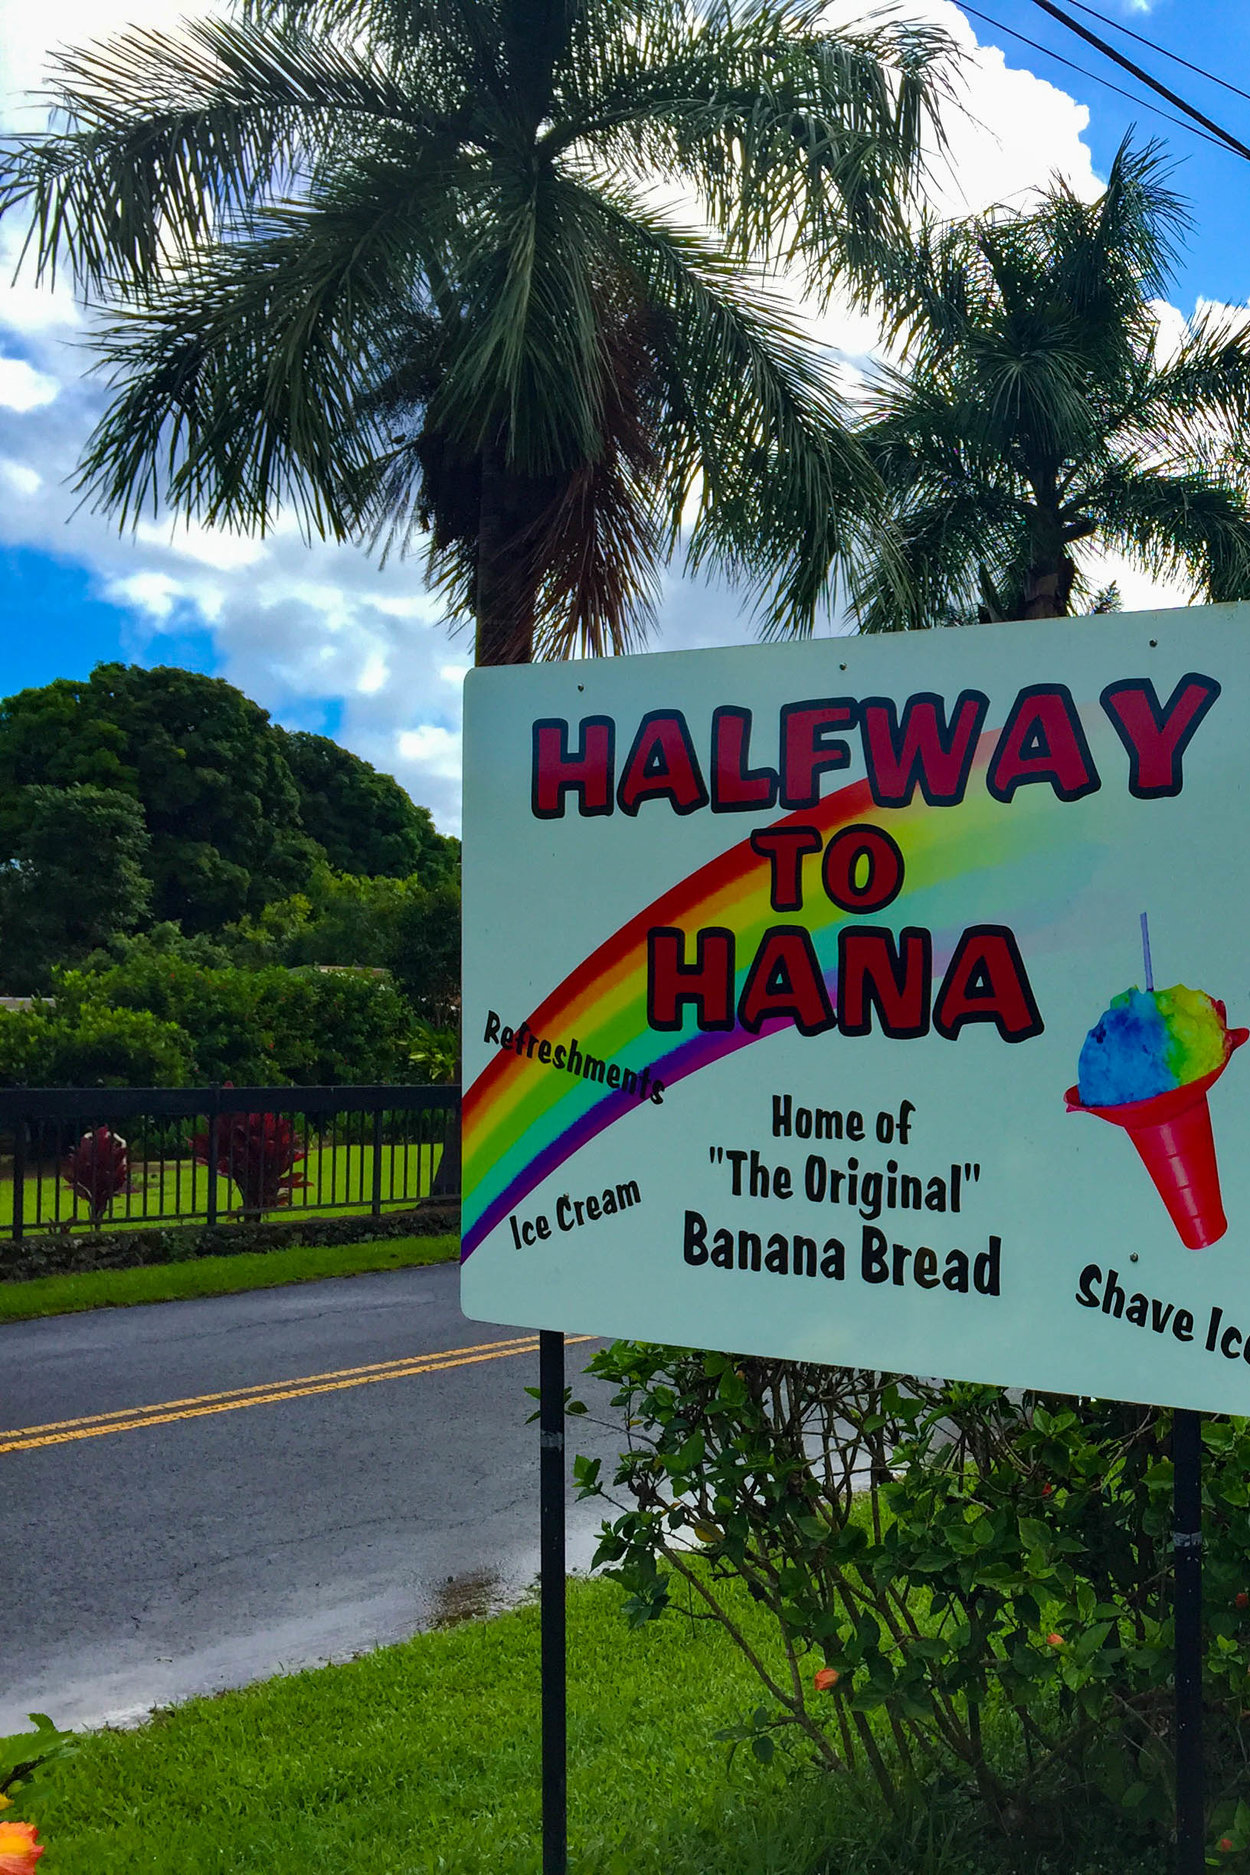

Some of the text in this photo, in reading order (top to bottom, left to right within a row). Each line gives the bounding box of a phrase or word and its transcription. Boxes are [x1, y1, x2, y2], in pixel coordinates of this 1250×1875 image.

[531, 673, 1222, 817] HALFWAY
[751, 824, 905, 914] TO
[647, 925, 1045, 1043] HANA
[484, 1010, 665, 1106] Refreshments
[771, 1094, 916, 1146] Home of
[509, 1179, 642, 1250] Ice Cream
[709, 1146, 981, 1219] "The Original"
[683, 1210, 1002, 1296] Banana Bread
[1075, 1263, 1195, 1343] Shave
